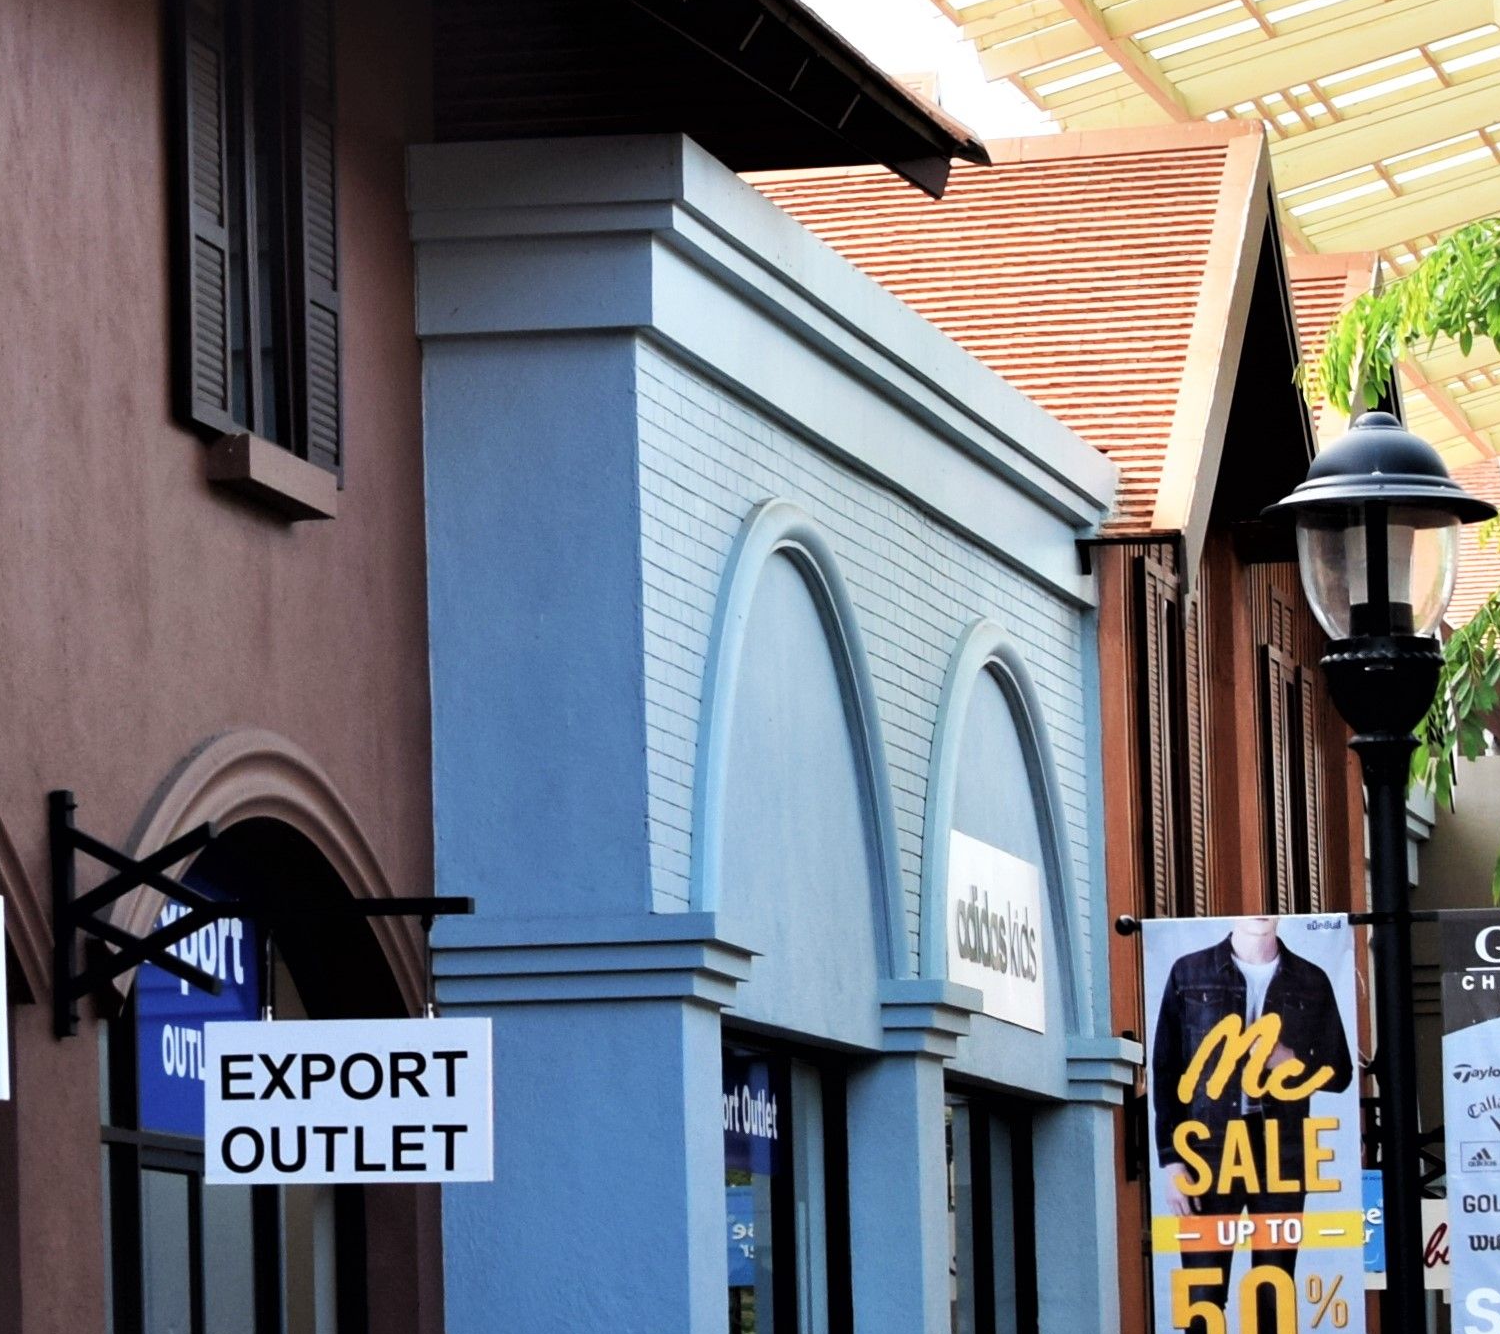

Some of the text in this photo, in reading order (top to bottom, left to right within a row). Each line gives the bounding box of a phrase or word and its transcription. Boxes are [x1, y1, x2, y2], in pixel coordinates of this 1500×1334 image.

[956, 884, 1037, 983] adidas kids
[161, 1023, 205, 1081] OUTL
[219, 1049, 469, 1102] EXPORT
[1177, 1012, 1335, 1105] Mc
[741, 1083, 778, 1141] Outlet
[220, 1123, 468, 1175] OUTLET
[1172, 1116, 1342, 1198] SALE
[1217, 1218, 1303, 1246] UP TO
